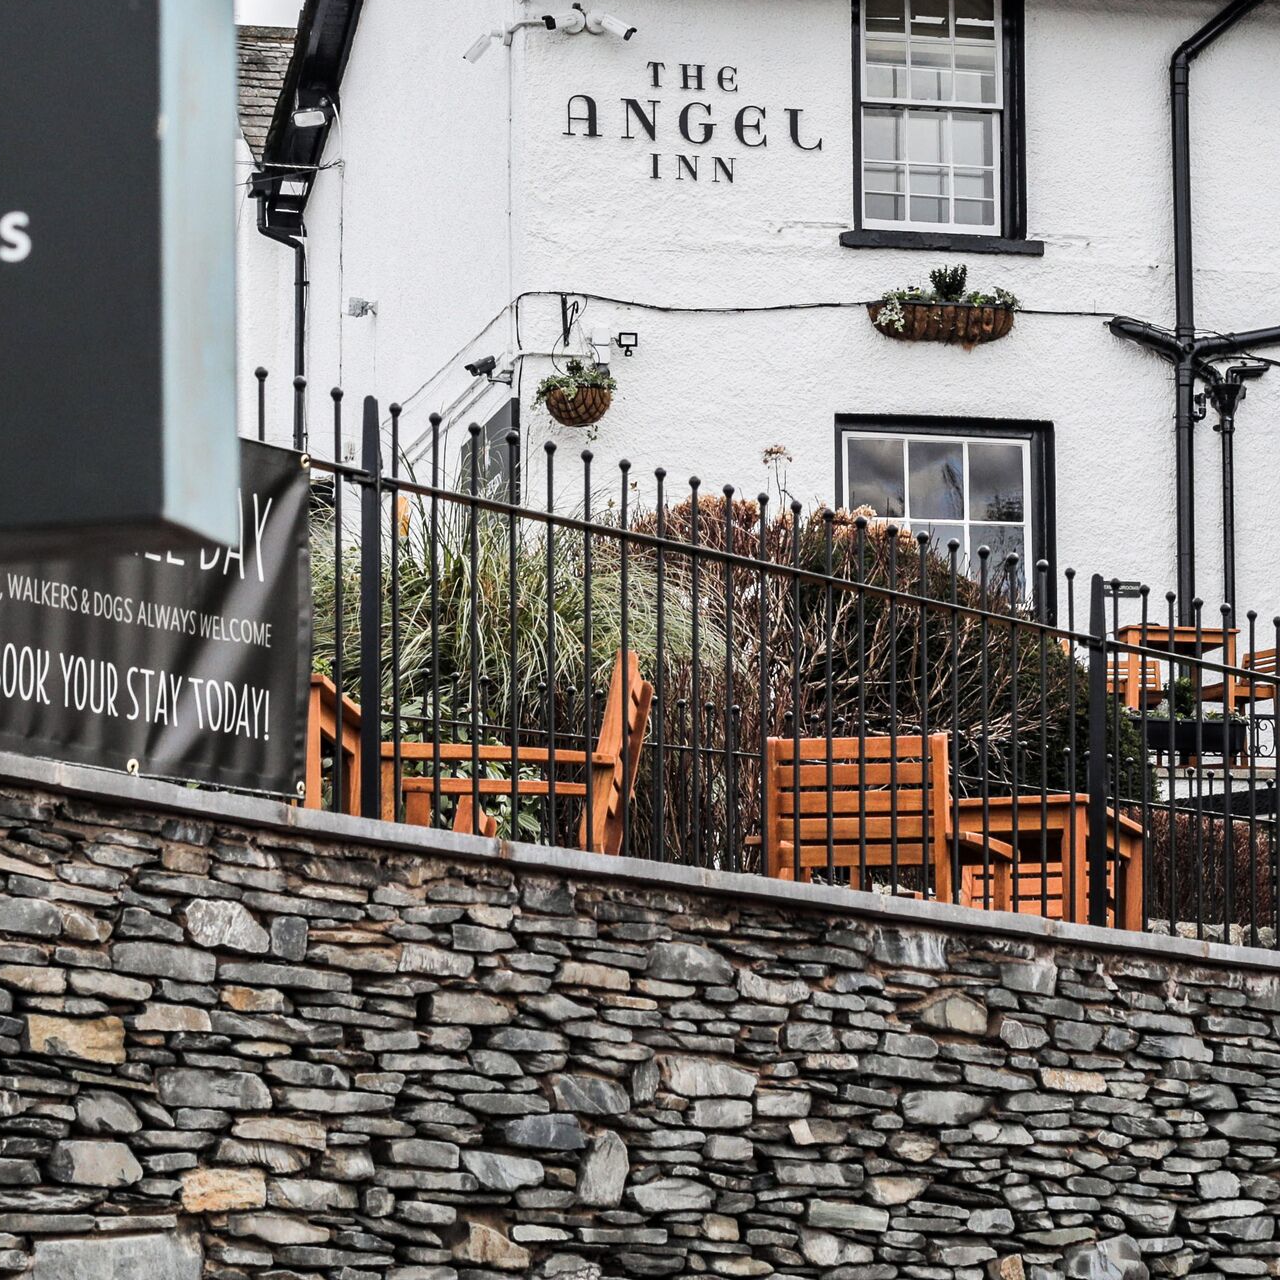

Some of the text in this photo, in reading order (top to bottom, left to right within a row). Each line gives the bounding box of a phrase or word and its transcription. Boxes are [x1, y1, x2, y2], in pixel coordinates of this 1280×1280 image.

[646, 61, 739, 93] THE
[562, 94, 823, 151] ANGEL
[649, 153, 737, 183] INN
[200, 487, 273, 582] AY
[7, 573, 78, 612] WALKERS
[80, 588, 90, 615] &
[93, 592, 133, 624] DOGS
[137, 601, 197, 636] ALWAYS
[200, 612, 272, 648] WELCOME
[60, 652, 119, 718] YOUR
[126, 666, 183, 727] STAY
[188, 677, 271, 742] TODAY!
